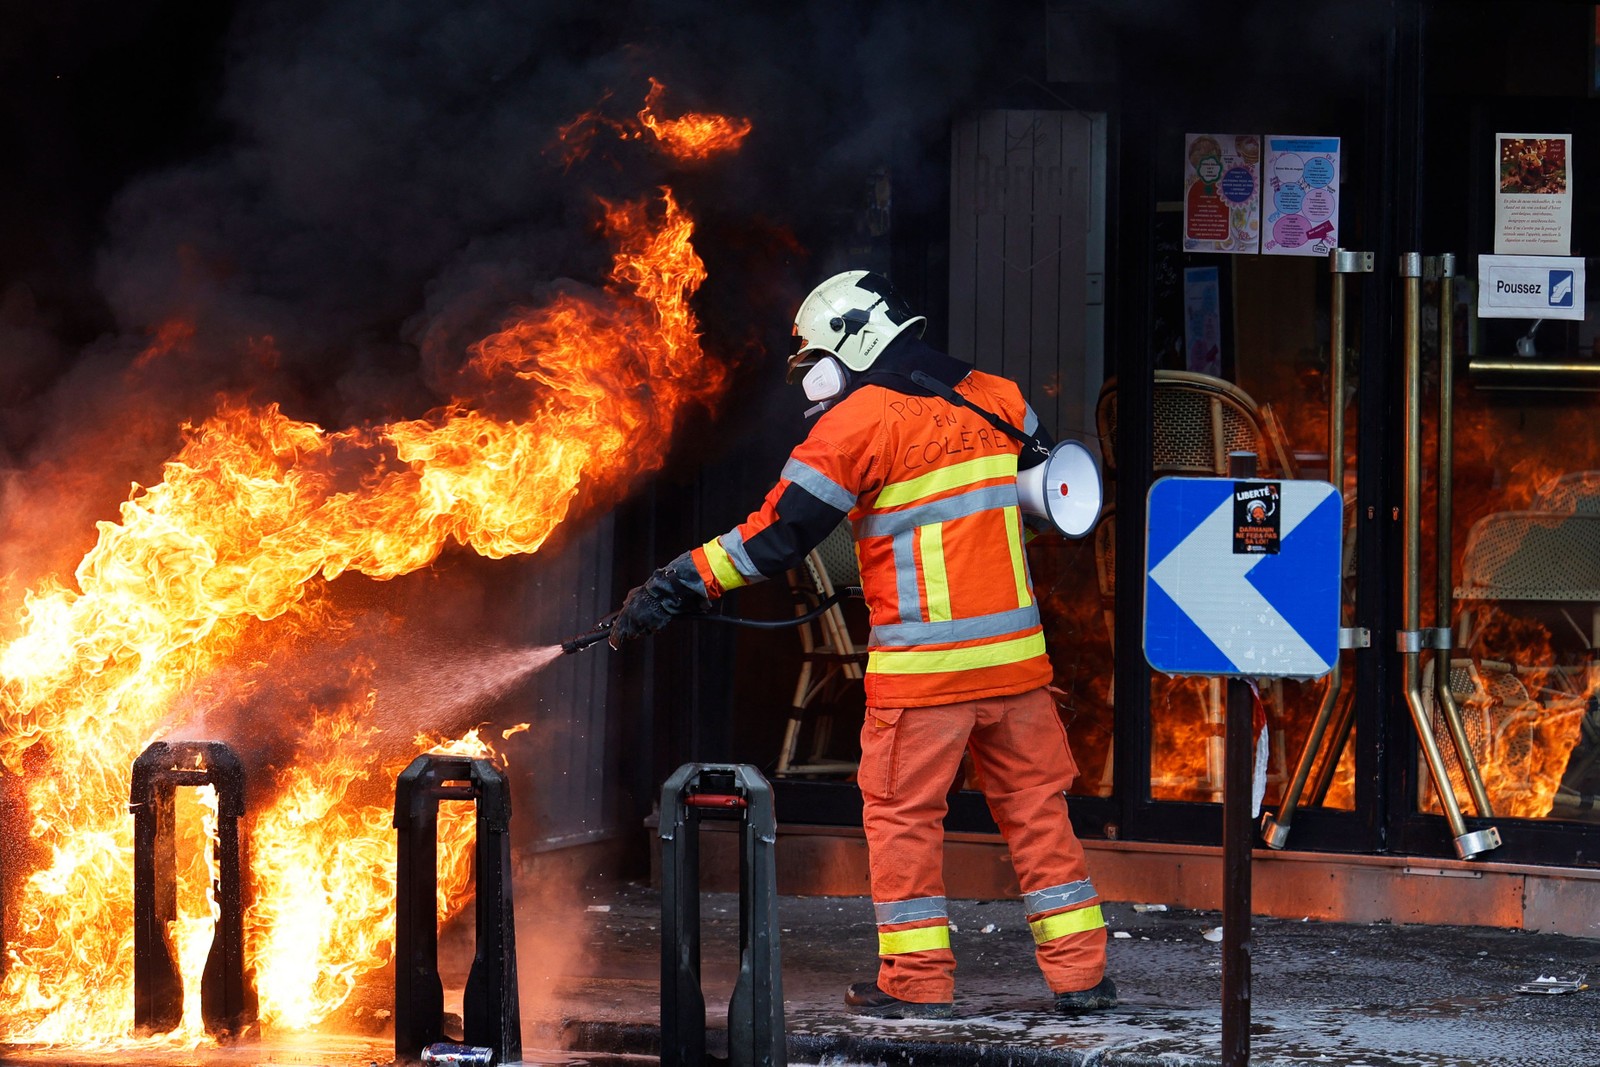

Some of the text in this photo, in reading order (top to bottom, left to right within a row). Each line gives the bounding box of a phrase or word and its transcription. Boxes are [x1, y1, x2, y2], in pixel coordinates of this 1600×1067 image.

[1496, 280, 1541, 294] Poussez
[864, 338, 879, 356] GALLET
[933, 413, 957, 428] EN
[904, 425, 1007, 470] COLÈRE
[1236, 485, 1270, 501] LIBERTÉ
